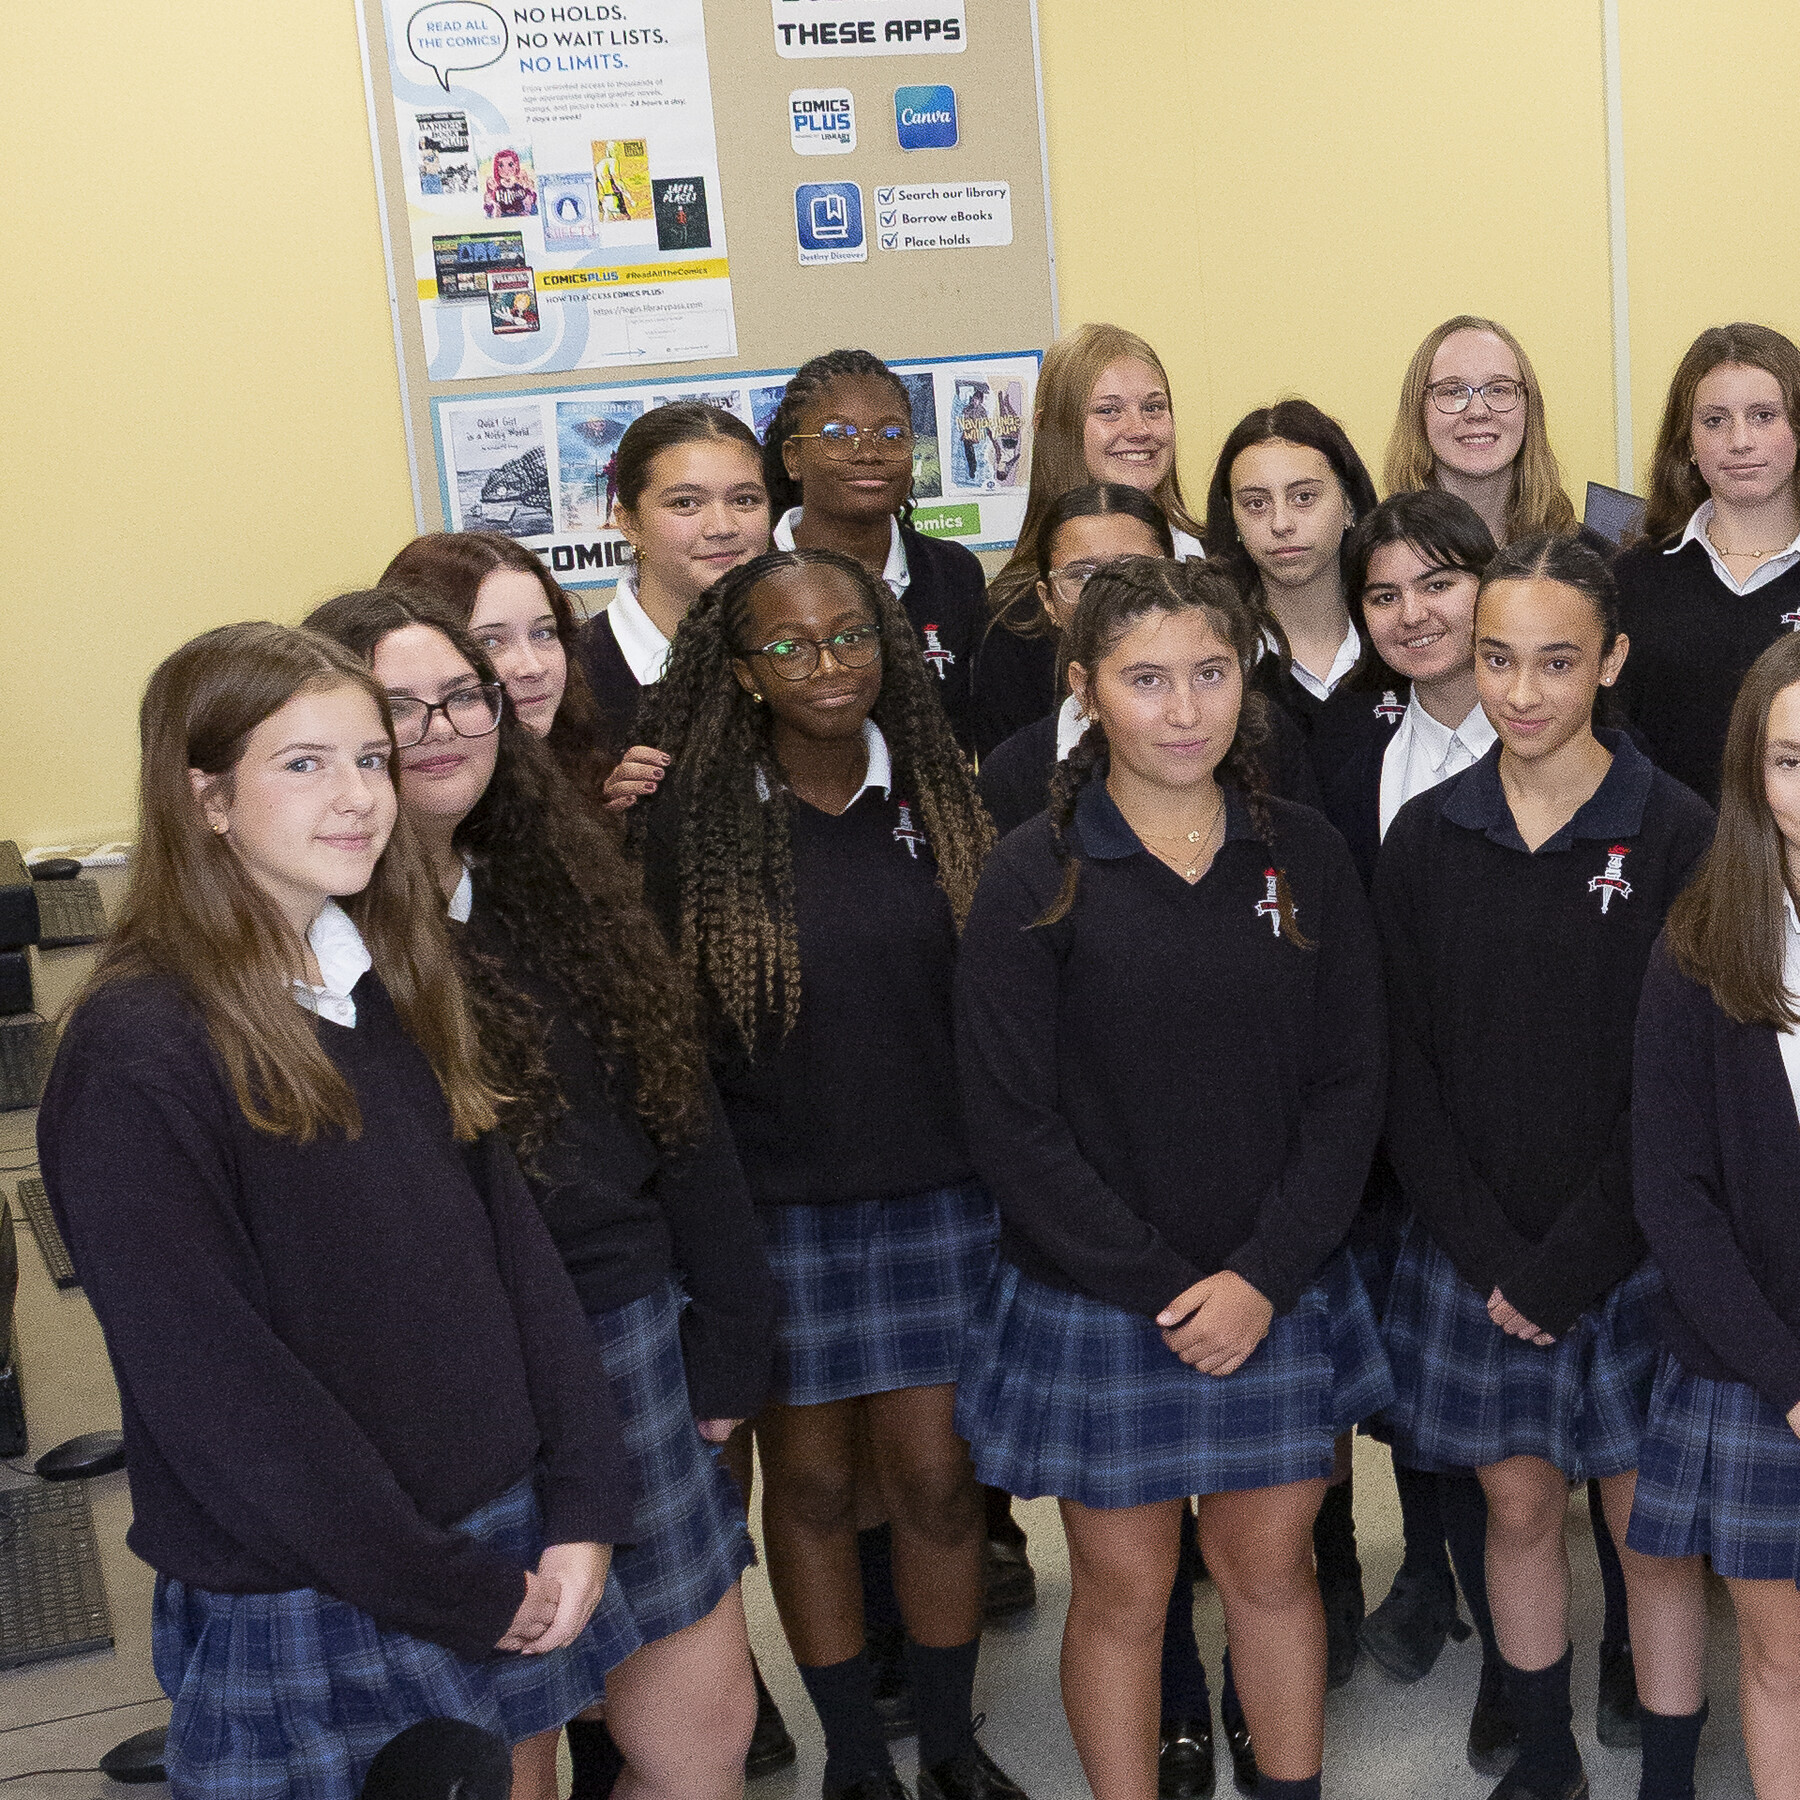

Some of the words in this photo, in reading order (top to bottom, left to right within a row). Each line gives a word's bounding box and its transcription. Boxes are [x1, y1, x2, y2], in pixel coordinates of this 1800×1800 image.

[514, 7, 546, 24] NO
[551, 5, 627, 22] HOLDS.
[426, 21, 462, 32] READ
[465, 19, 489, 31] ALL
[777, 21, 876, 46] THESE
[885, 18, 961, 42] APPS
[417, 37, 443, 48] THE
[446, 34, 501, 47] COMICS!
[516, 32, 548, 49] NO
[554, 31, 604, 47] WAIT
[611, 28, 669, 46] LISTS.
[520, 56, 552, 73] NO
[558, 53, 628, 72] LIMITS.
[792, 99, 850, 114] COMICS
[794, 113, 851, 132] PLUS
[901, 108, 952, 126] Canva
[898, 188, 940, 201] Search
[942, 190, 963, 199] our
[966, 187, 1007, 200] library
[902, 212, 947, 224] Borrow
[950, 210, 993, 222] eBooks
[904, 236, 936, 247] Place
[939, 234, 971, 246] holds
[800, 252, 830, 263] Destiny
[831, 250, 865, 261] Discover
[626, 267, 708, 280] #ReadAllTheComics
[546, 296, 567, 304] HOW
[568, 293, 580, 303] TO
[581, 292, 612, 302] ACCESS
[613, 290, 641, 299] COMICS
